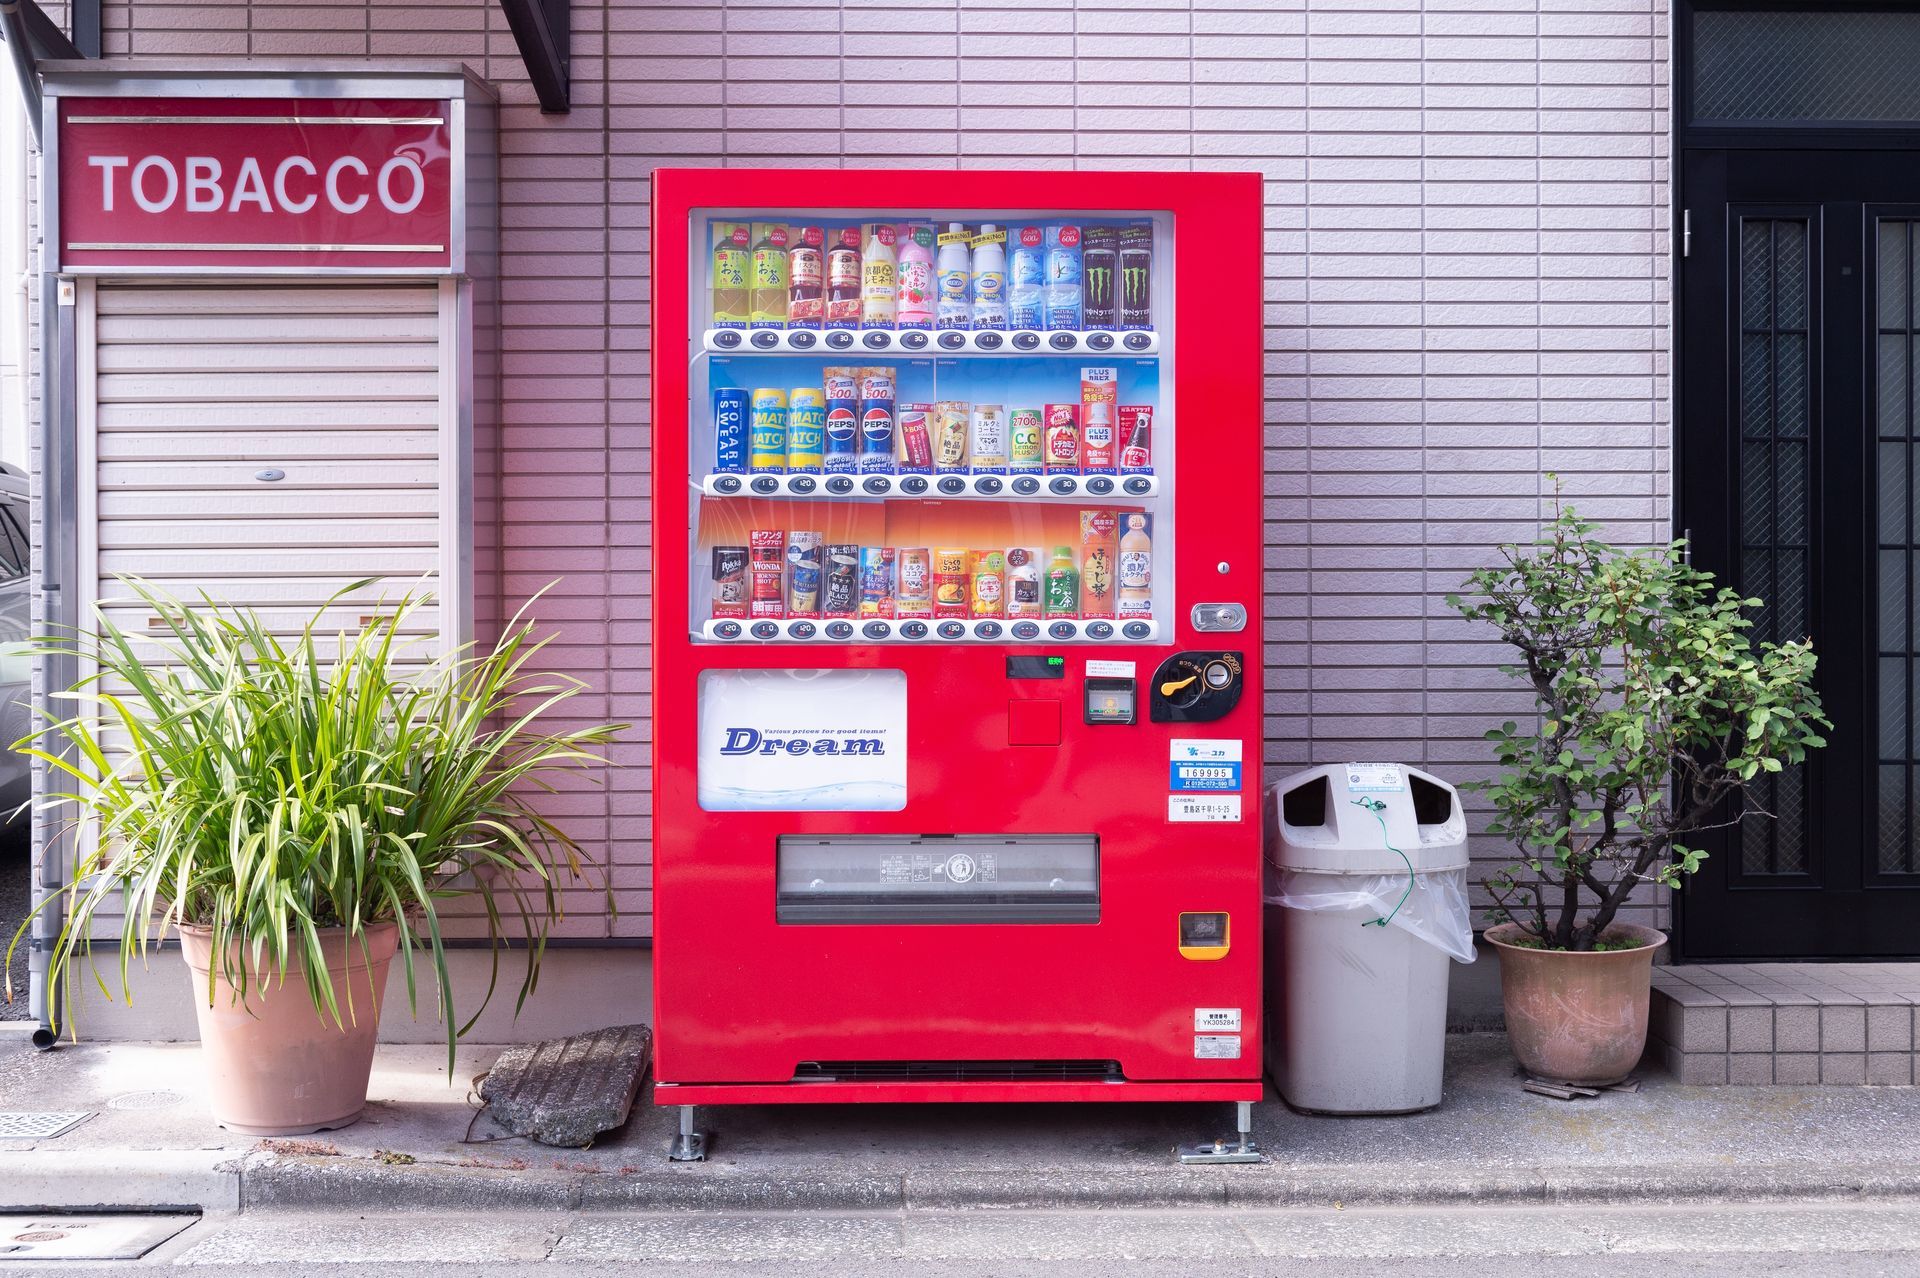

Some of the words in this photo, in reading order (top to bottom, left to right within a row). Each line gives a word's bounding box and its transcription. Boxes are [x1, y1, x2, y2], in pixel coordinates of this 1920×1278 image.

[88, 155, 425, 214] TOBACCO
[865, 266, 880, 275] 京都
[865, 276, 894, 284] レモネード
[1084, 393, 1114, 402] 免疫キープ
[720, 401, 729, 460] SWEAT
[729, 401, 738, 467] POCARI
[944, 439, 960, 449] 絶品
[1016, 433, 1039, 445] C.C.
[722, 560, 741, 572] Pokka
[753, 561, 780, 570] WONDA
[1127, 563, 1144, 571] 濃厚
[1091, 548, 1106, 600] ほうじ茶
[832, 583, 848, 592] 絶品
[1051, 579, 1073, 607] お茶
[720, 728, 885, 756] Dream
[1186, 769, 1226, 777] 169995
